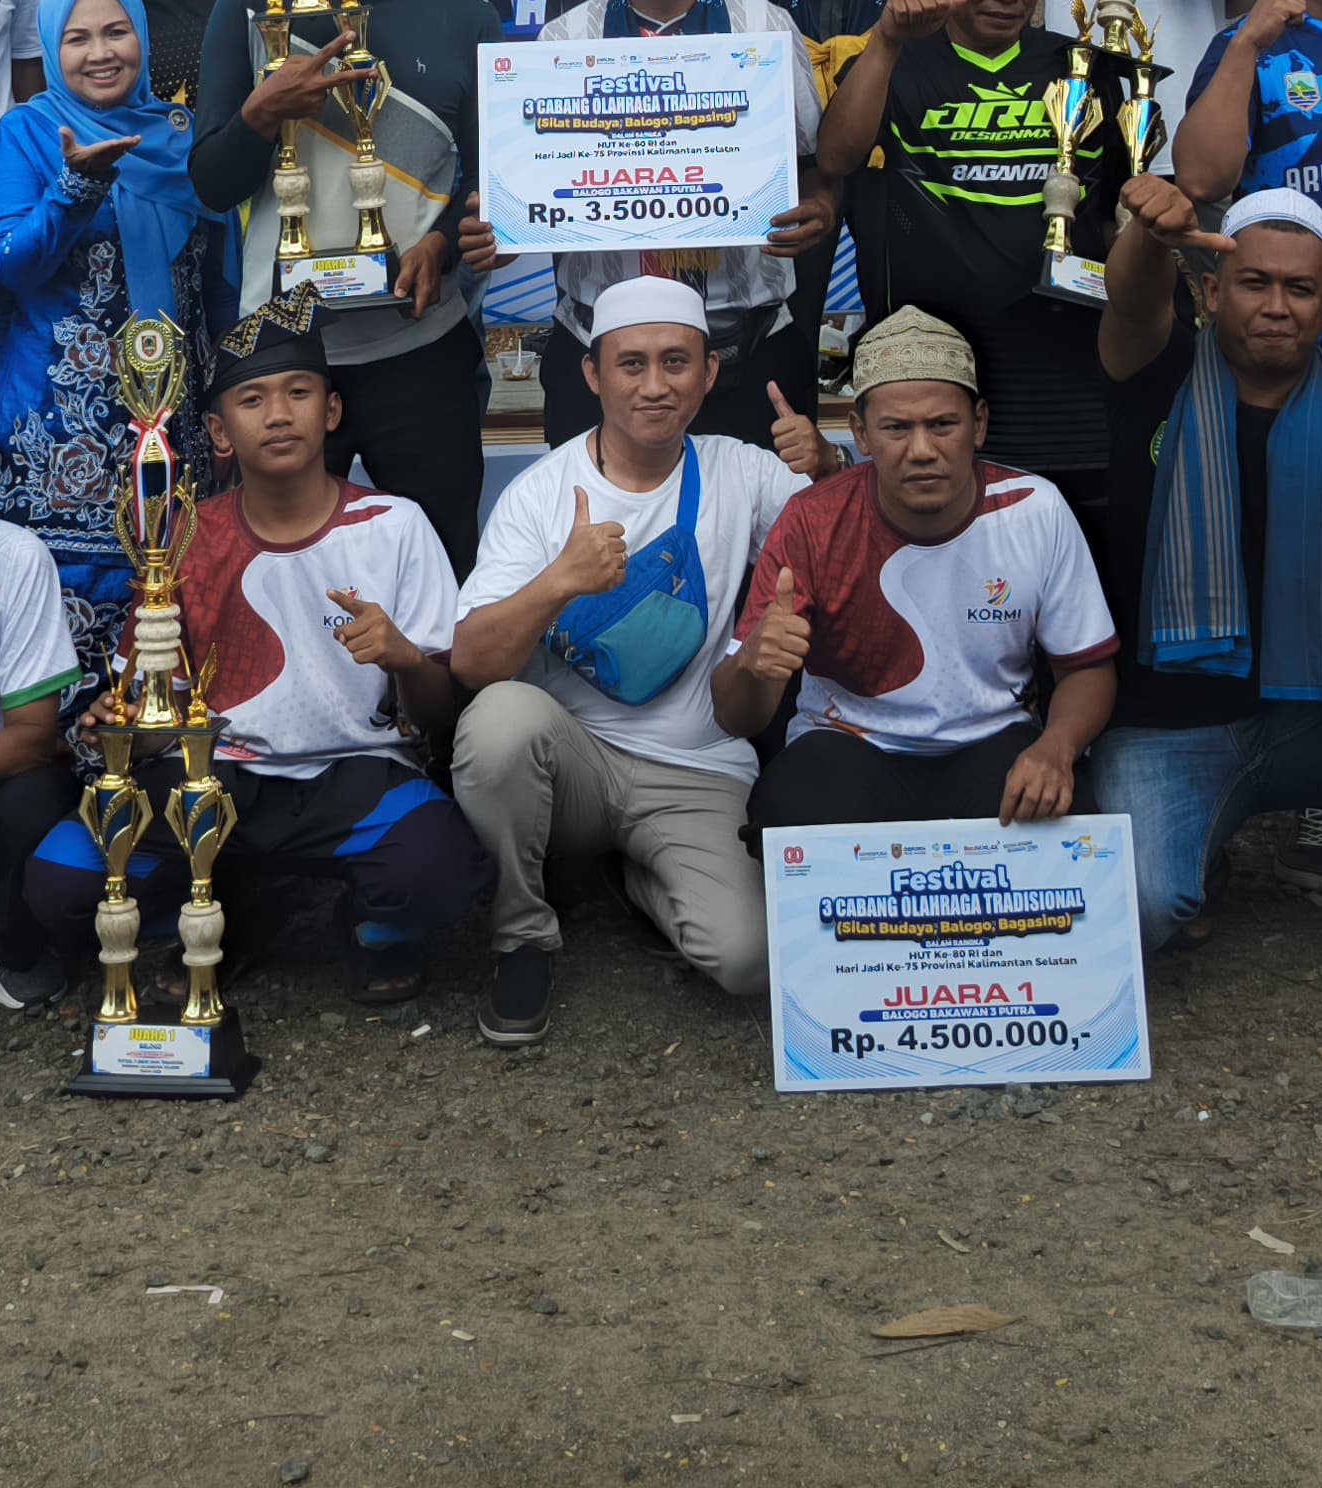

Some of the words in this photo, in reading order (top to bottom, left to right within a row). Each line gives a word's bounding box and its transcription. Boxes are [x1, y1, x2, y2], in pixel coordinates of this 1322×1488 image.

[585, 69, 686, 95] Festival
[524, 101, 535, 116] 3
[536, 98, 590, 115] CABANG
[592, 95, 662, 115] OLAHRAGA
[663, 91, 749, 112] TRADISIONAL
[537, 116, 570, 130] (Silat
[674, 111, 737, 126] Bagasing)
[535, 151, 555, 161] Hari
[556, 150, 577, 160] Jadi
[607, 148, 645, 158] Provinsi
[646, 146, 703, 157] Kalimantan
[704, 145, 741, 155] Selatan
[659, 139, 678, 147] dan
[571, 167, 672, 187] JUARA
[676, 165, 705, 183] 2
[572, 188, 612, 198] BALOGO
[613, 186, 663, 197] BAKAWAN
[672, 184, 703, 194] PUTRA
[528, 202, 574, 228] Rp.
[585, 196, 749, 222] 3.500.000,-
[966, 607, 1022, 622] KORMI
[892, 862, 1010, 892] Festival
[821, 898, 833, 918] 3
[835, 896, 898, 918] CABANG
[901, 892, 981, 918] OLAHRAGA
[983, 889, 1084, 914] TRADISIONAL
[836, 920, 876, 935] (Silat
[998, 913, 1072, 931] Bagasing)
[908, 950, 931, 960] HUT
[933, 949, 967, 959] Ke-80
[968, 949, 980, 959] RI
[981, 948, 1003, 958] dan
[836, 965, 859, 975] Hari
[861, 963, 884, 974] Jadi
[886, 962, 919, 973] Ke-75
[920, 960, 965, 970] Provinsi
[967, 958, 1033, 969] Kalimantan
[1035, 957, 1077, 967] Selatan
[883, 983, 1010, 1008] JUARA
[1017, 981, 1034, 1002] 1
[882, 1009, 928, 1021] BALOGO
[929, 1007, 989, 1019] BAKAWAN
[990, 1006, 999, 1017] 3
[998, 1005, 1036, 1017] PUTRA
[831, 1027, 885, 1059] Rp.
[897, 1020, 1092, 1052] 4.500.000,-
